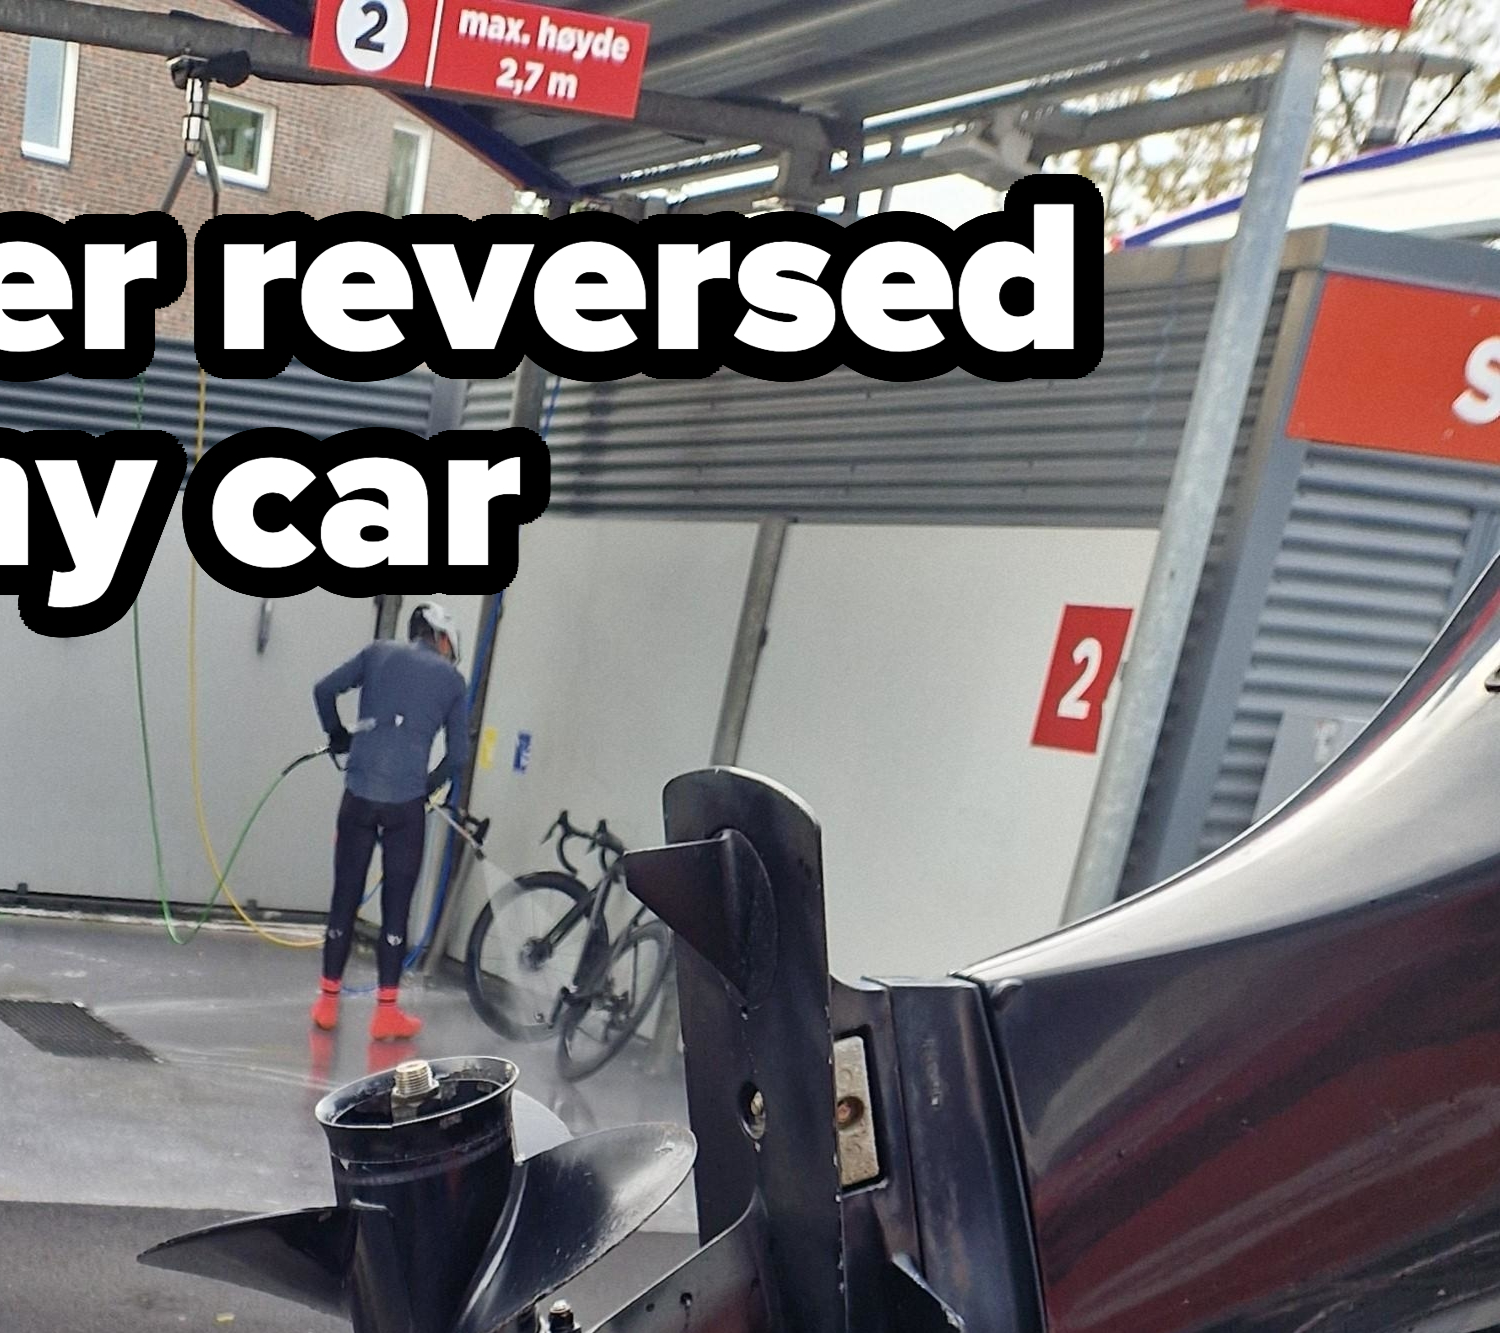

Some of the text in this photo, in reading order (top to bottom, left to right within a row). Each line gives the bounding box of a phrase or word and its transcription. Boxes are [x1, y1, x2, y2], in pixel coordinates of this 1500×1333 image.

[354, 1, 389, 53] 2
[457, 8, 630, 61] max. høyde
[494, 56, 579, 100] 2,7 m
[1056, 636, 1103, 720] 2
